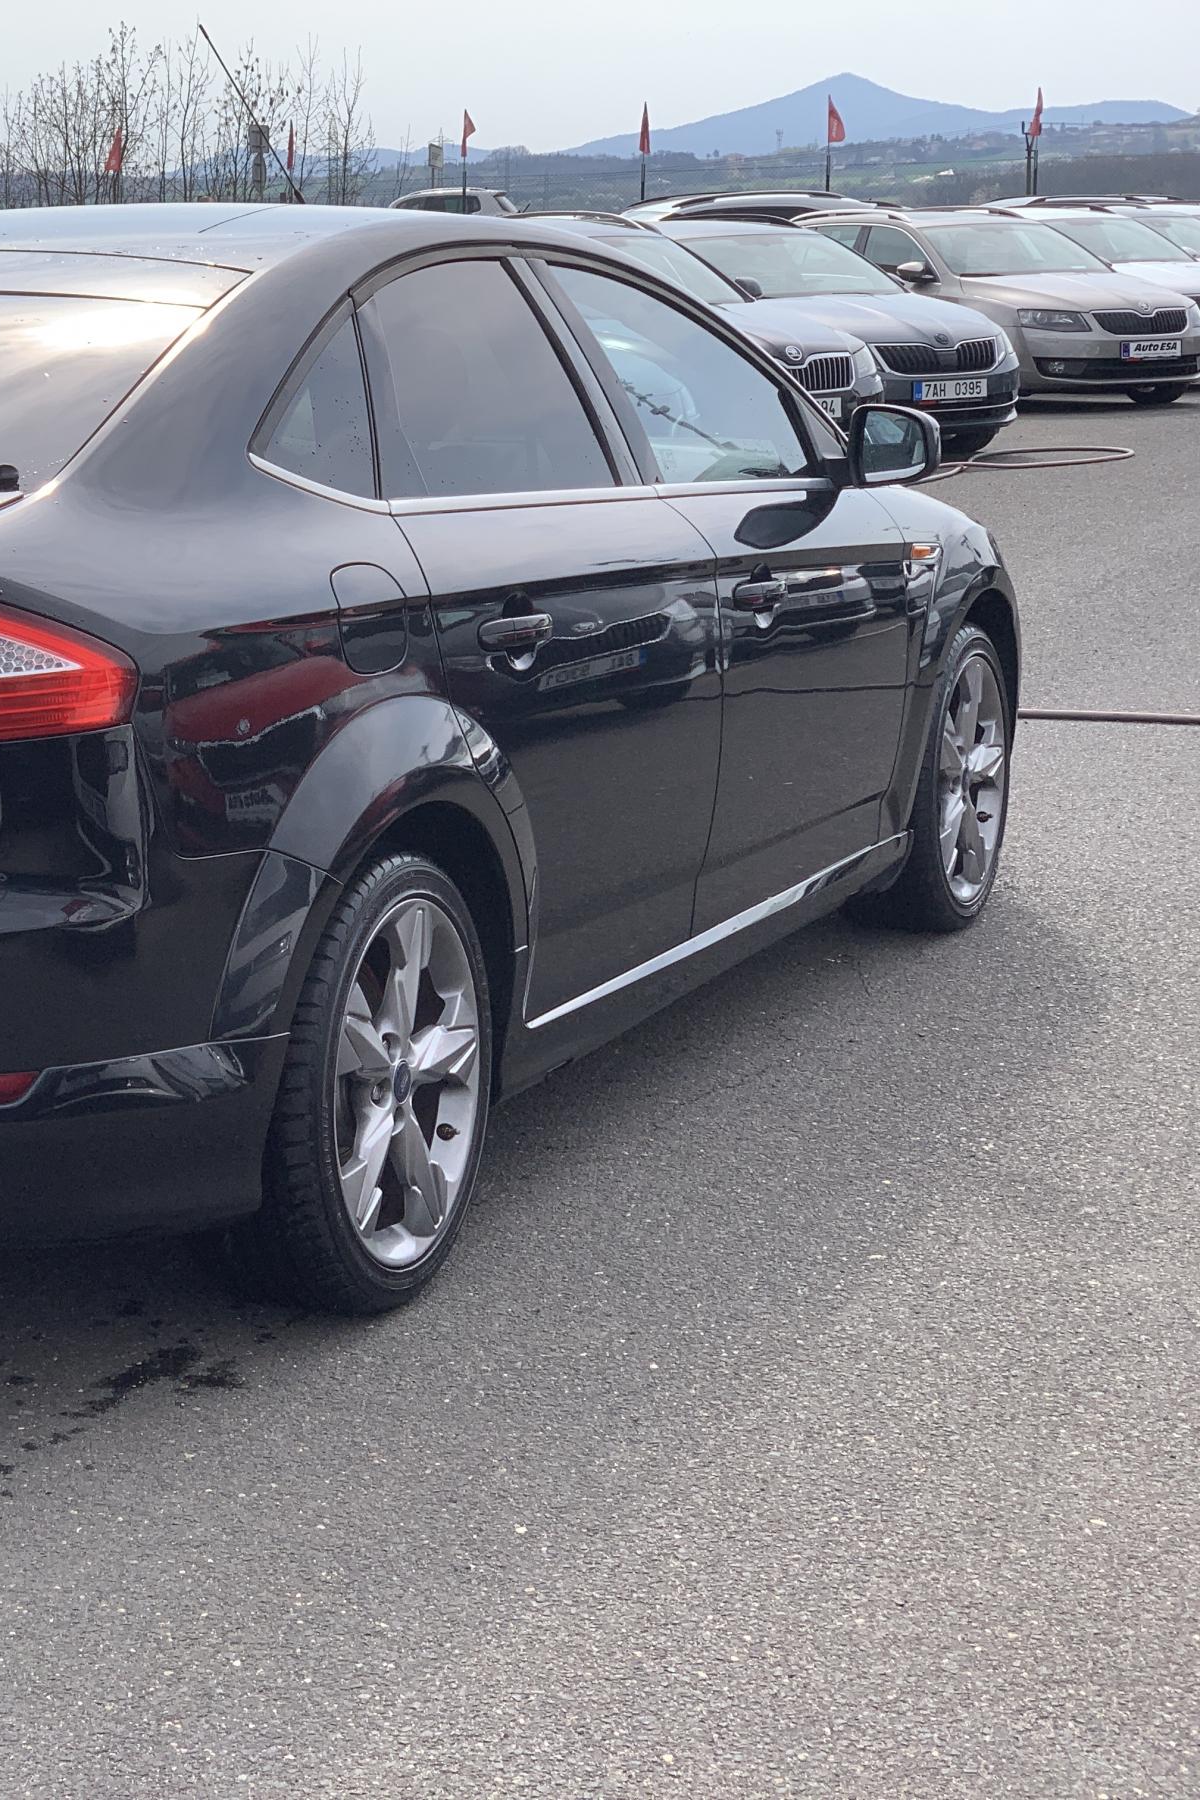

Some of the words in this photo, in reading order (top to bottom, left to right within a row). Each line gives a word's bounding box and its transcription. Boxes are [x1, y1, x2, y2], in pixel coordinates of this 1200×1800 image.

[1134, 342, 1159, 352] Auto
[1160, 341, 1178, 351] ESA
[924, 383, 946, 398] 7AH
[954, 381, 982, 396] 0395
[817, 399, 836, 415] 94
